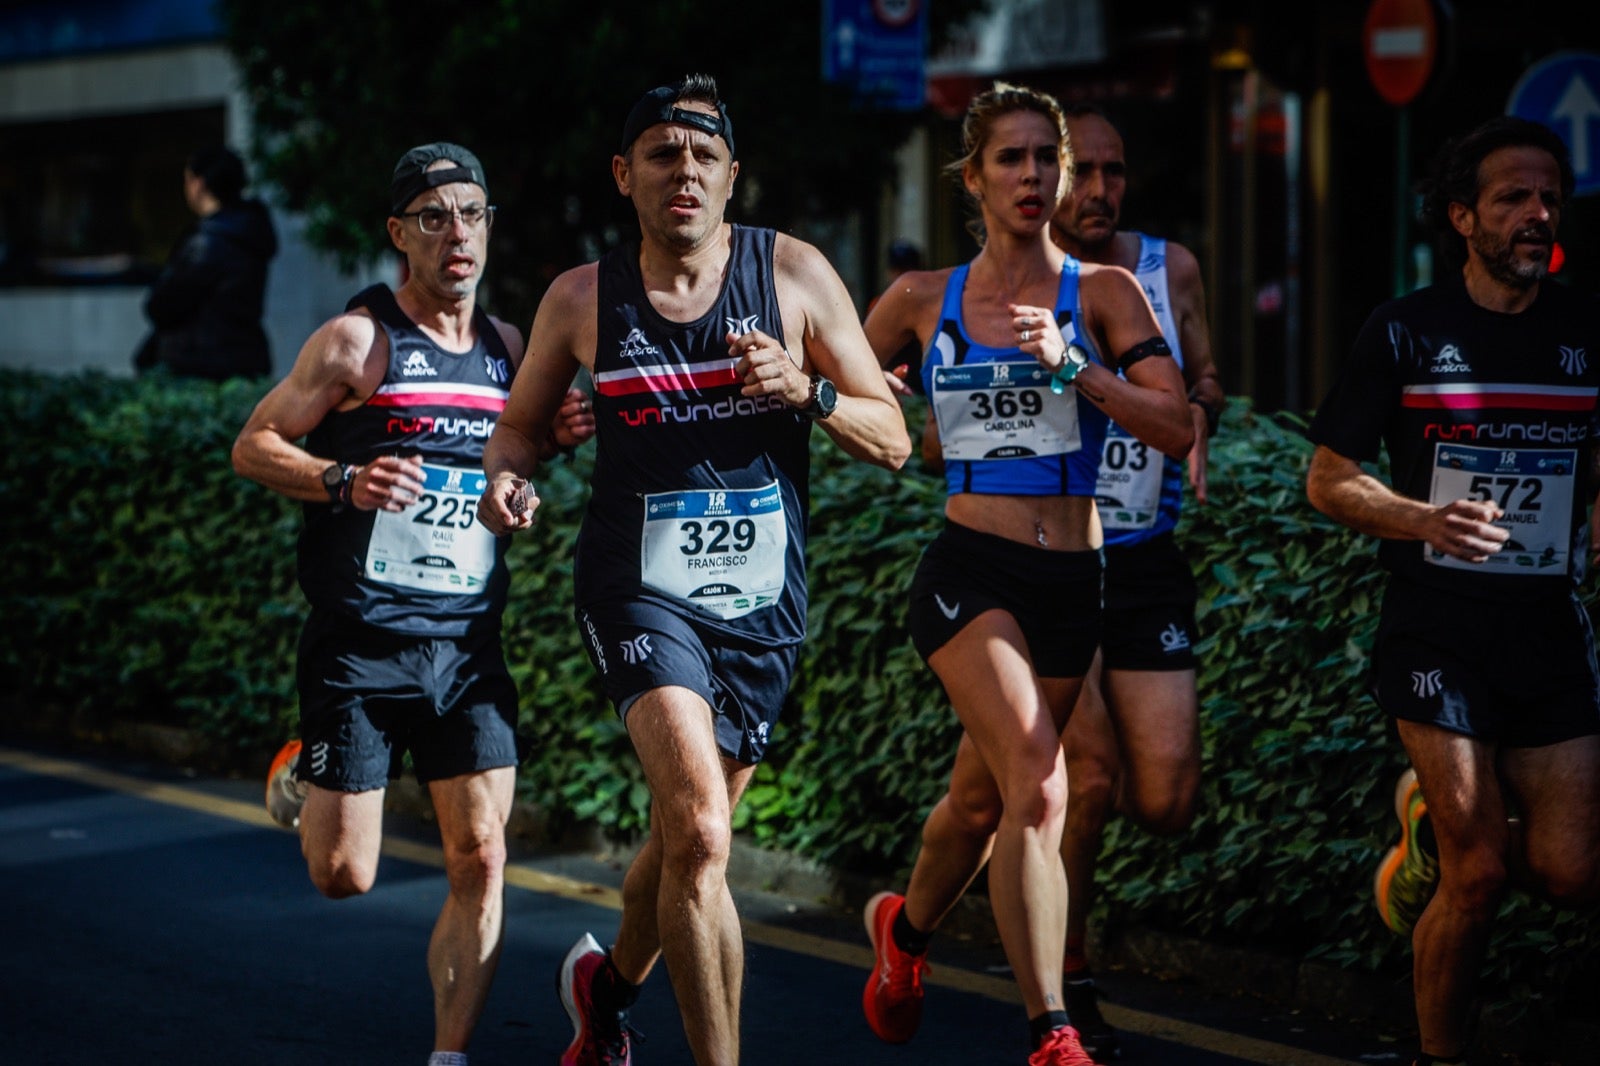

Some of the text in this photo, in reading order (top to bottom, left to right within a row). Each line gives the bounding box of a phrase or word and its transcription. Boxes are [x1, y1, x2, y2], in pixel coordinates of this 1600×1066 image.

[617, 394, 789, 426] unrundata
[969, 389, 1042, 420] 369
[984, 419, 1035, 432] CAROLINA
[1424, 420, 1588, 444] runrundata
[1100, 440, 1147, 471] 03
[1468, 475, 1543, 511] 572
[412, 494, 476, 530] 225
[680, 518, 756, 556] 329
[687, 555, 747, 569] FRANCISCO
